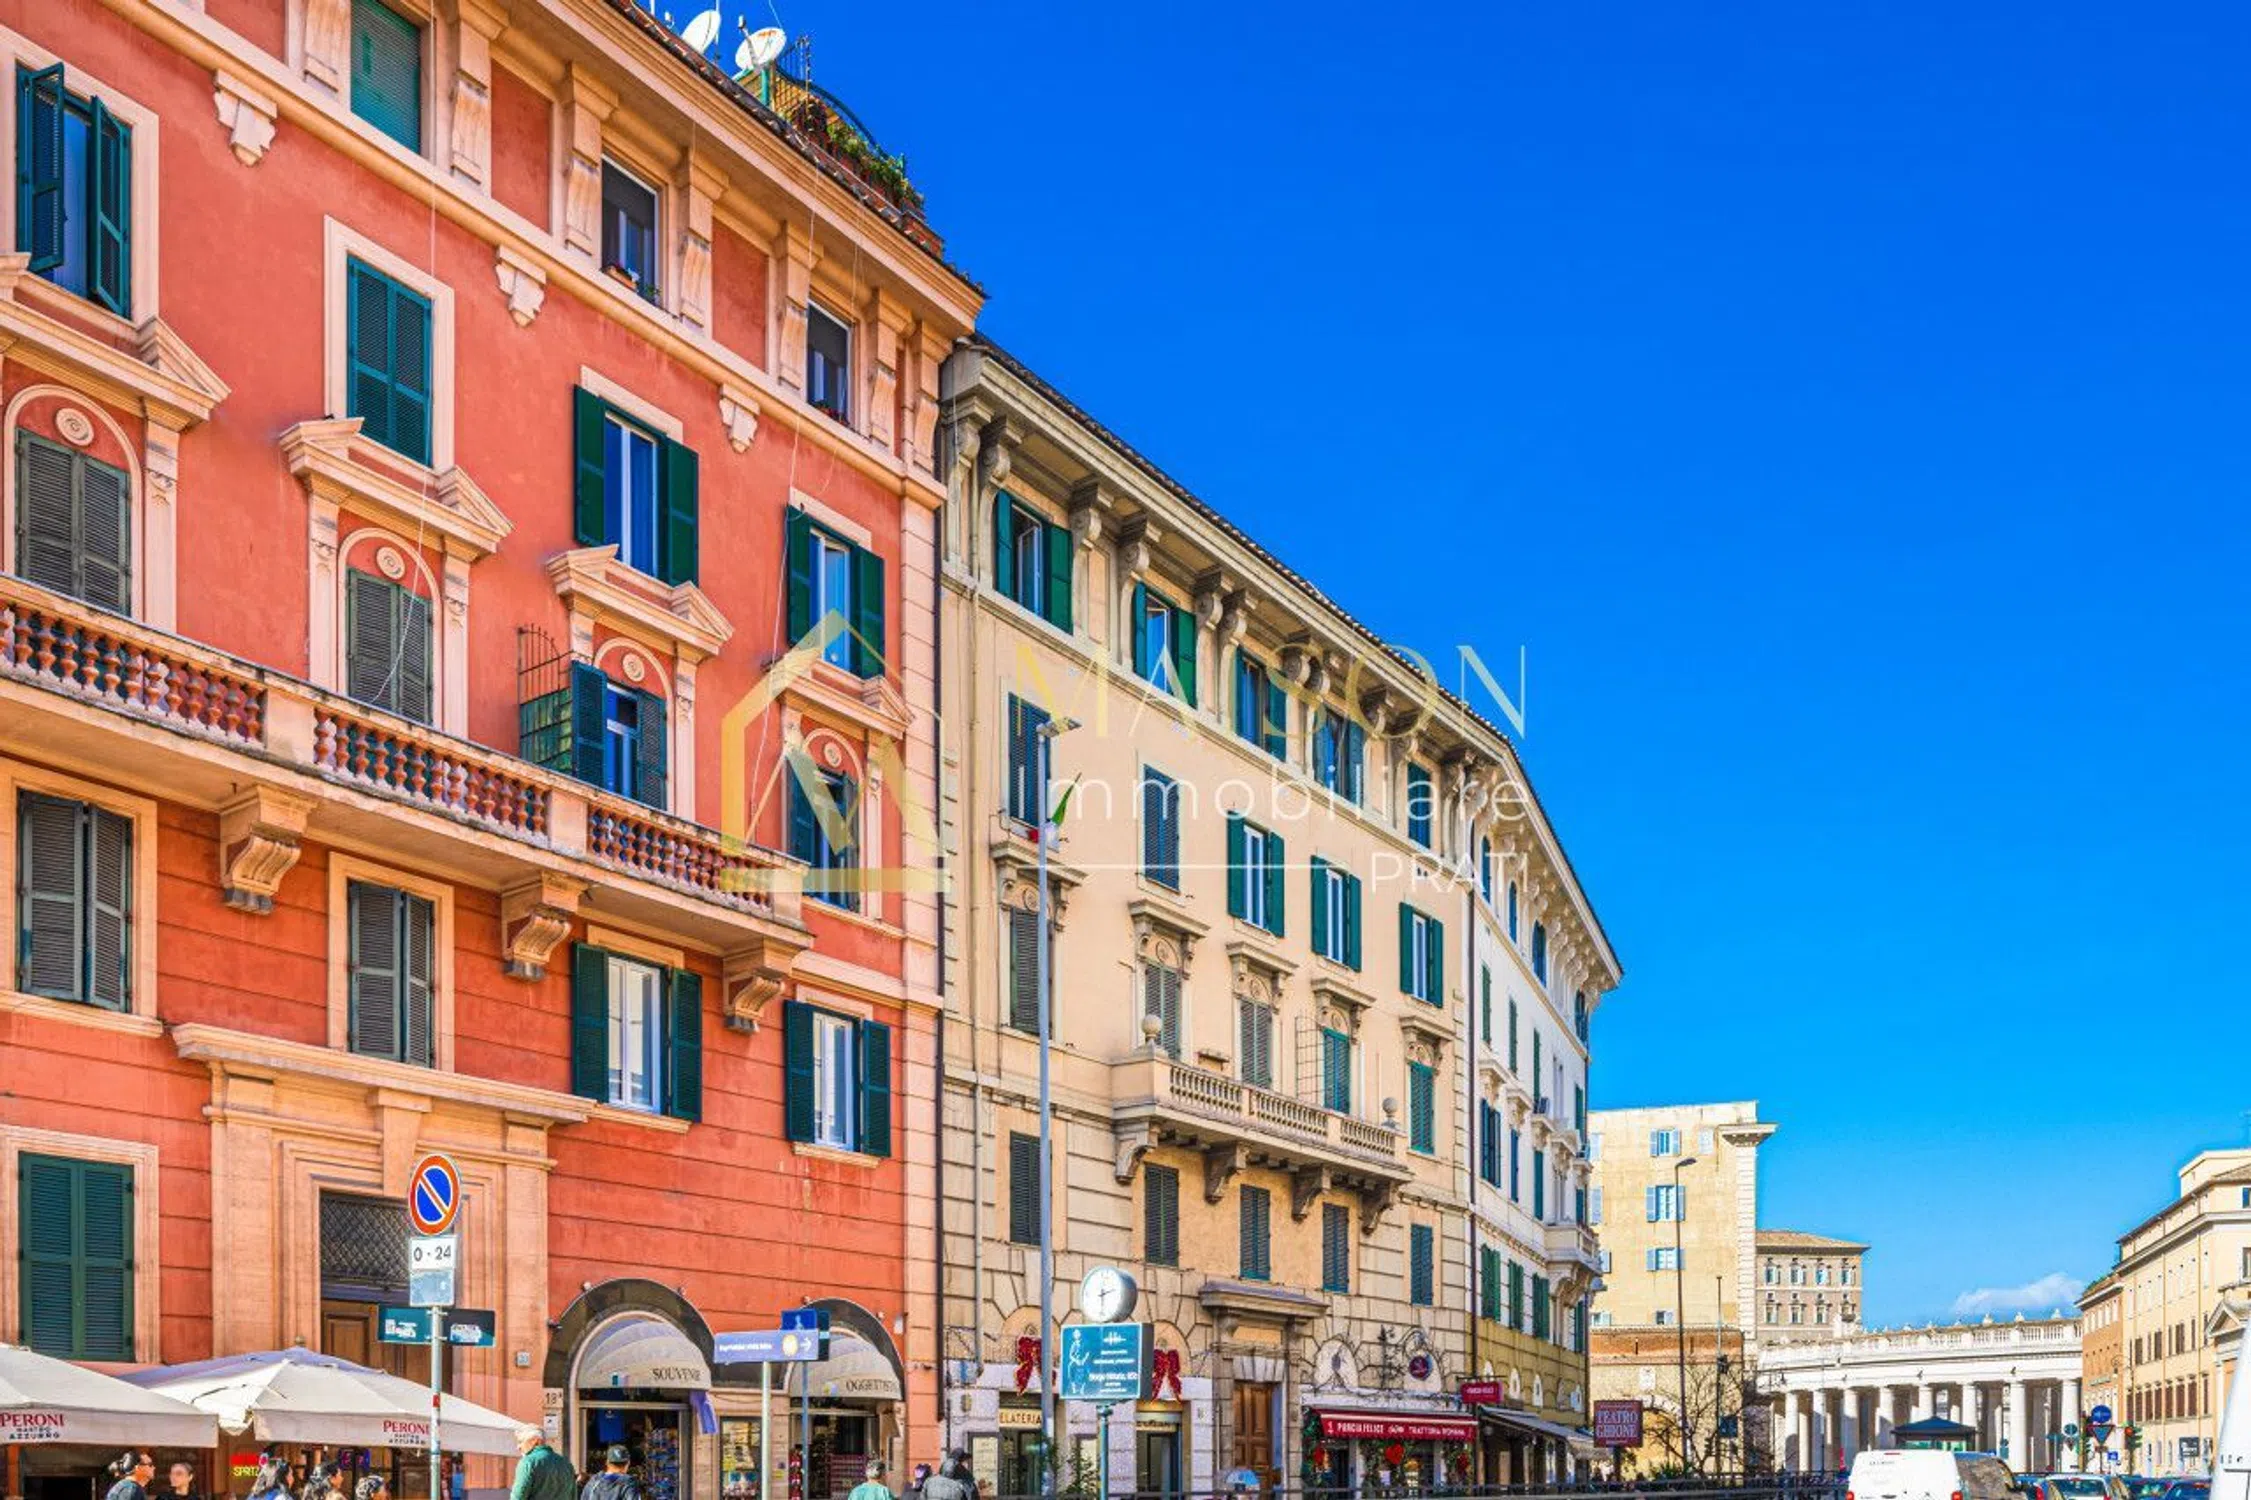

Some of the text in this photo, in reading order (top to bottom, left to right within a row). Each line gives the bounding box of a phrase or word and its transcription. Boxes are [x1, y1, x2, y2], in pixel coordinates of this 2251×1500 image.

[435, 1245, 452, 1260] 24
[0, 1412, 65, 1427] PERONI
[999, 1412, 1042, 1424] ELATERIA
[1596, 1410, 1638, 1424] TEATRO
[383, 1419, 430, 1436] PERONI
